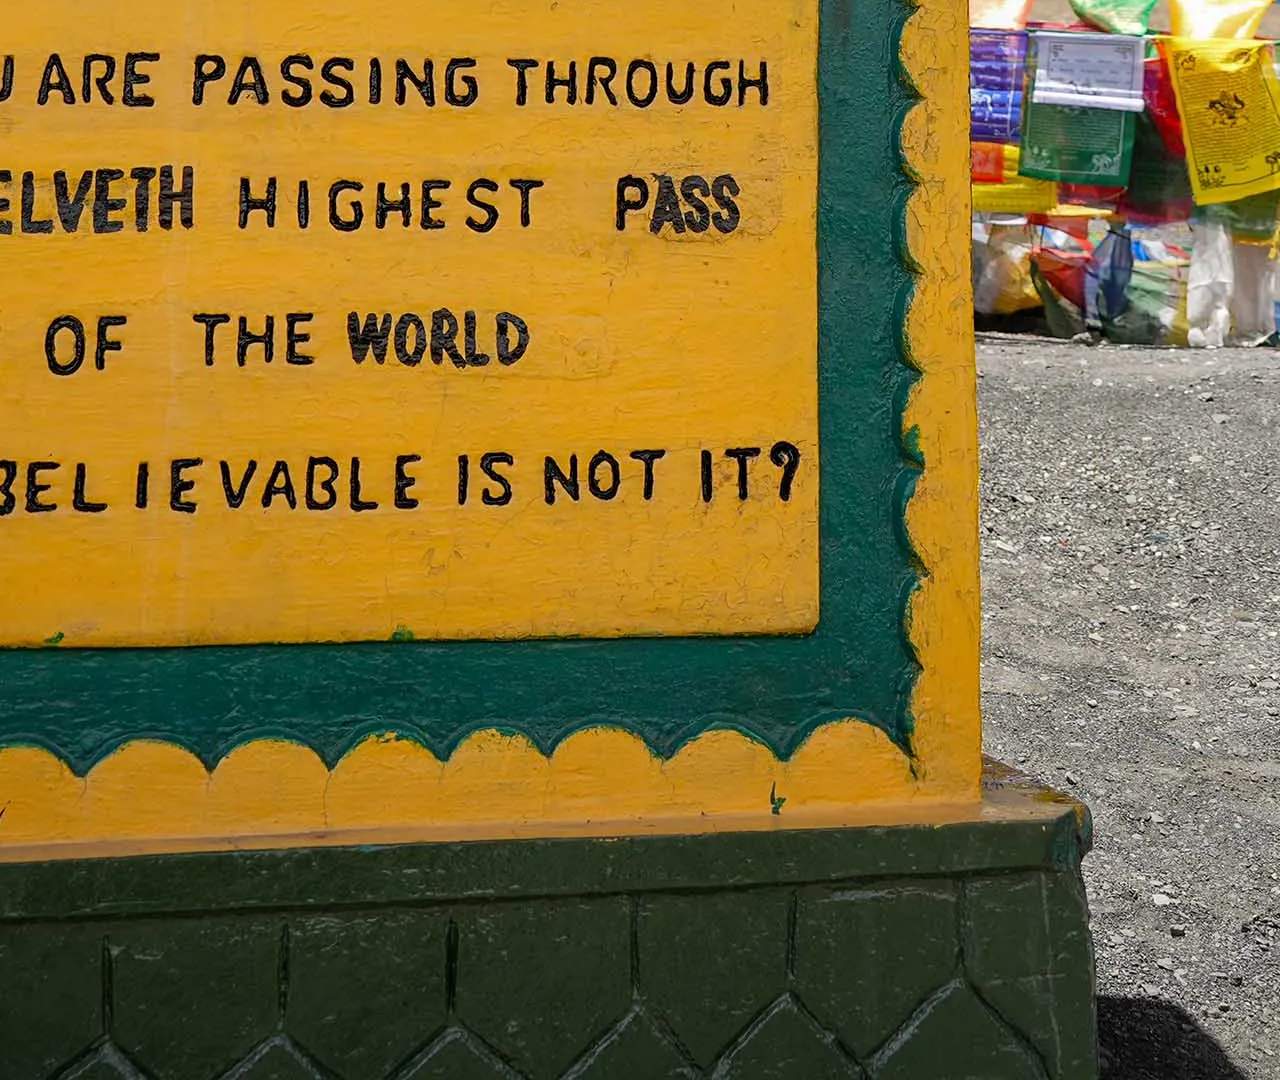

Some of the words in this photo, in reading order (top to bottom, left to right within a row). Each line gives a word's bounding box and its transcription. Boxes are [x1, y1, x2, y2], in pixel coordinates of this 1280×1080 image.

[37, 51, 161, 108] ARE
[192, 54, 479, 109] PASSING
[506, 56, 769, 109] THROUGH
[238, 176, 545, 233] HIGHEST
[615, 172, 741, 235] PASS
[44, 315, 128, 377] OF
[192, 312, 314, 368] THE
[347, 307, 530, 369] WORLD
[458, 451, 514, 507] IS
[544, 449, 666, 506] NOT
[700, 440, 801, 503] IT?
